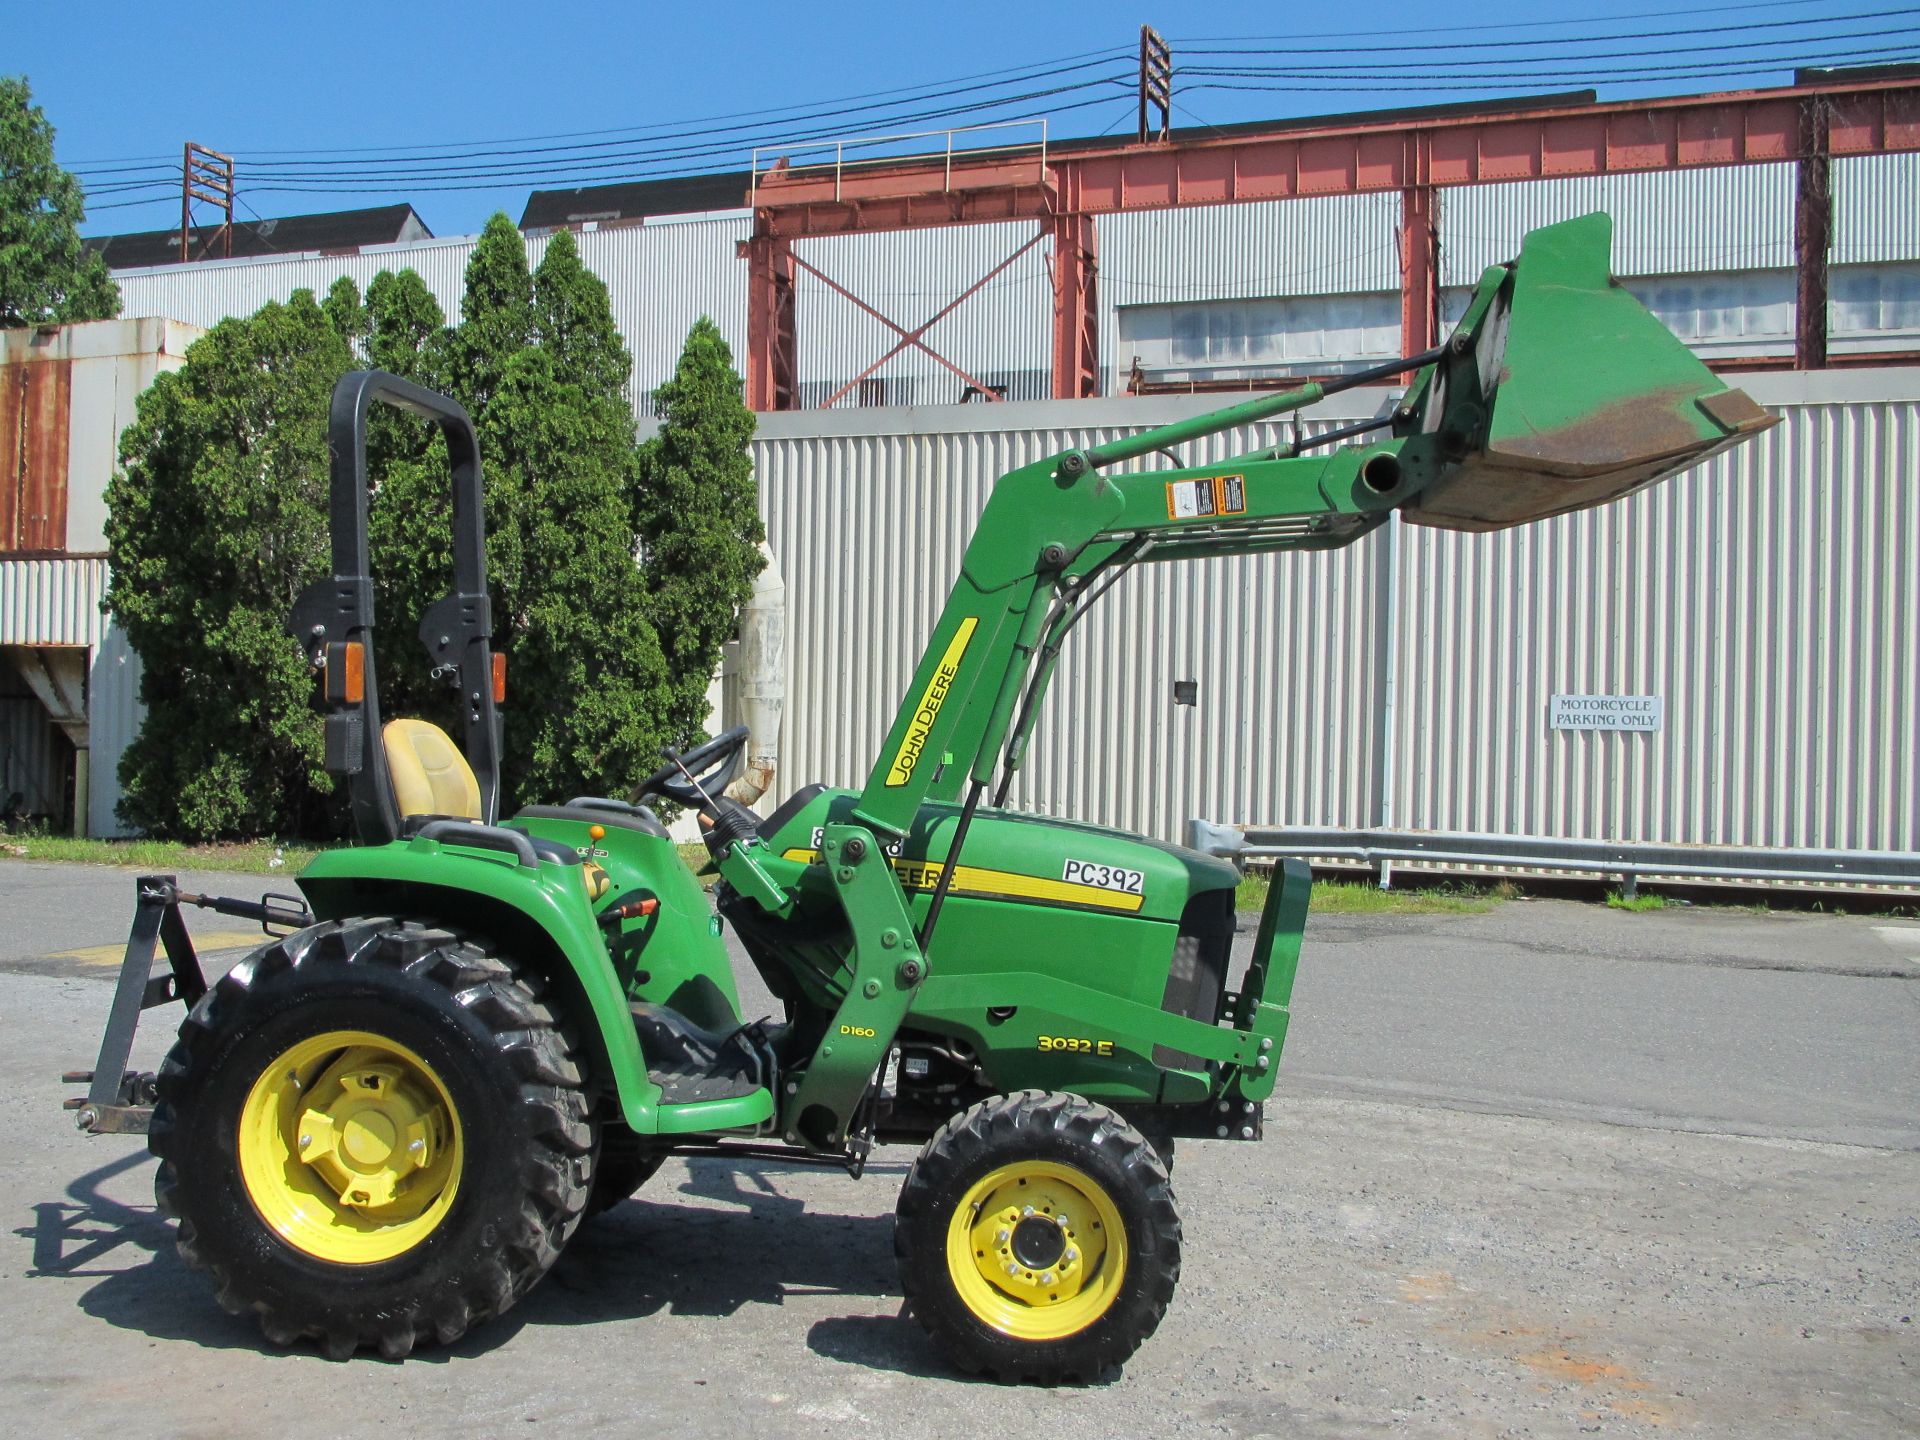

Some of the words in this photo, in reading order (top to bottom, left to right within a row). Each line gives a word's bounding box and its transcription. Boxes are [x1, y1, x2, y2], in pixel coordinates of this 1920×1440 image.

[1561, 699, 1651, 711] MOTORCYCLE
[895, 729, 926, 781] JOHN
[916, 664, 955, 727] DEERE
[1557, 713, 1616, 725] PARKING
[1621, 715, 1656, 726] ONLY
[896, 867, 957, 888] EER
[1064, 861, 1141, 892] PC392
[841, 1025, 875, 1037] D160
[1038, 1035, 1092, 1053] 3032
[1097, 1040, 1113, 1056] E
